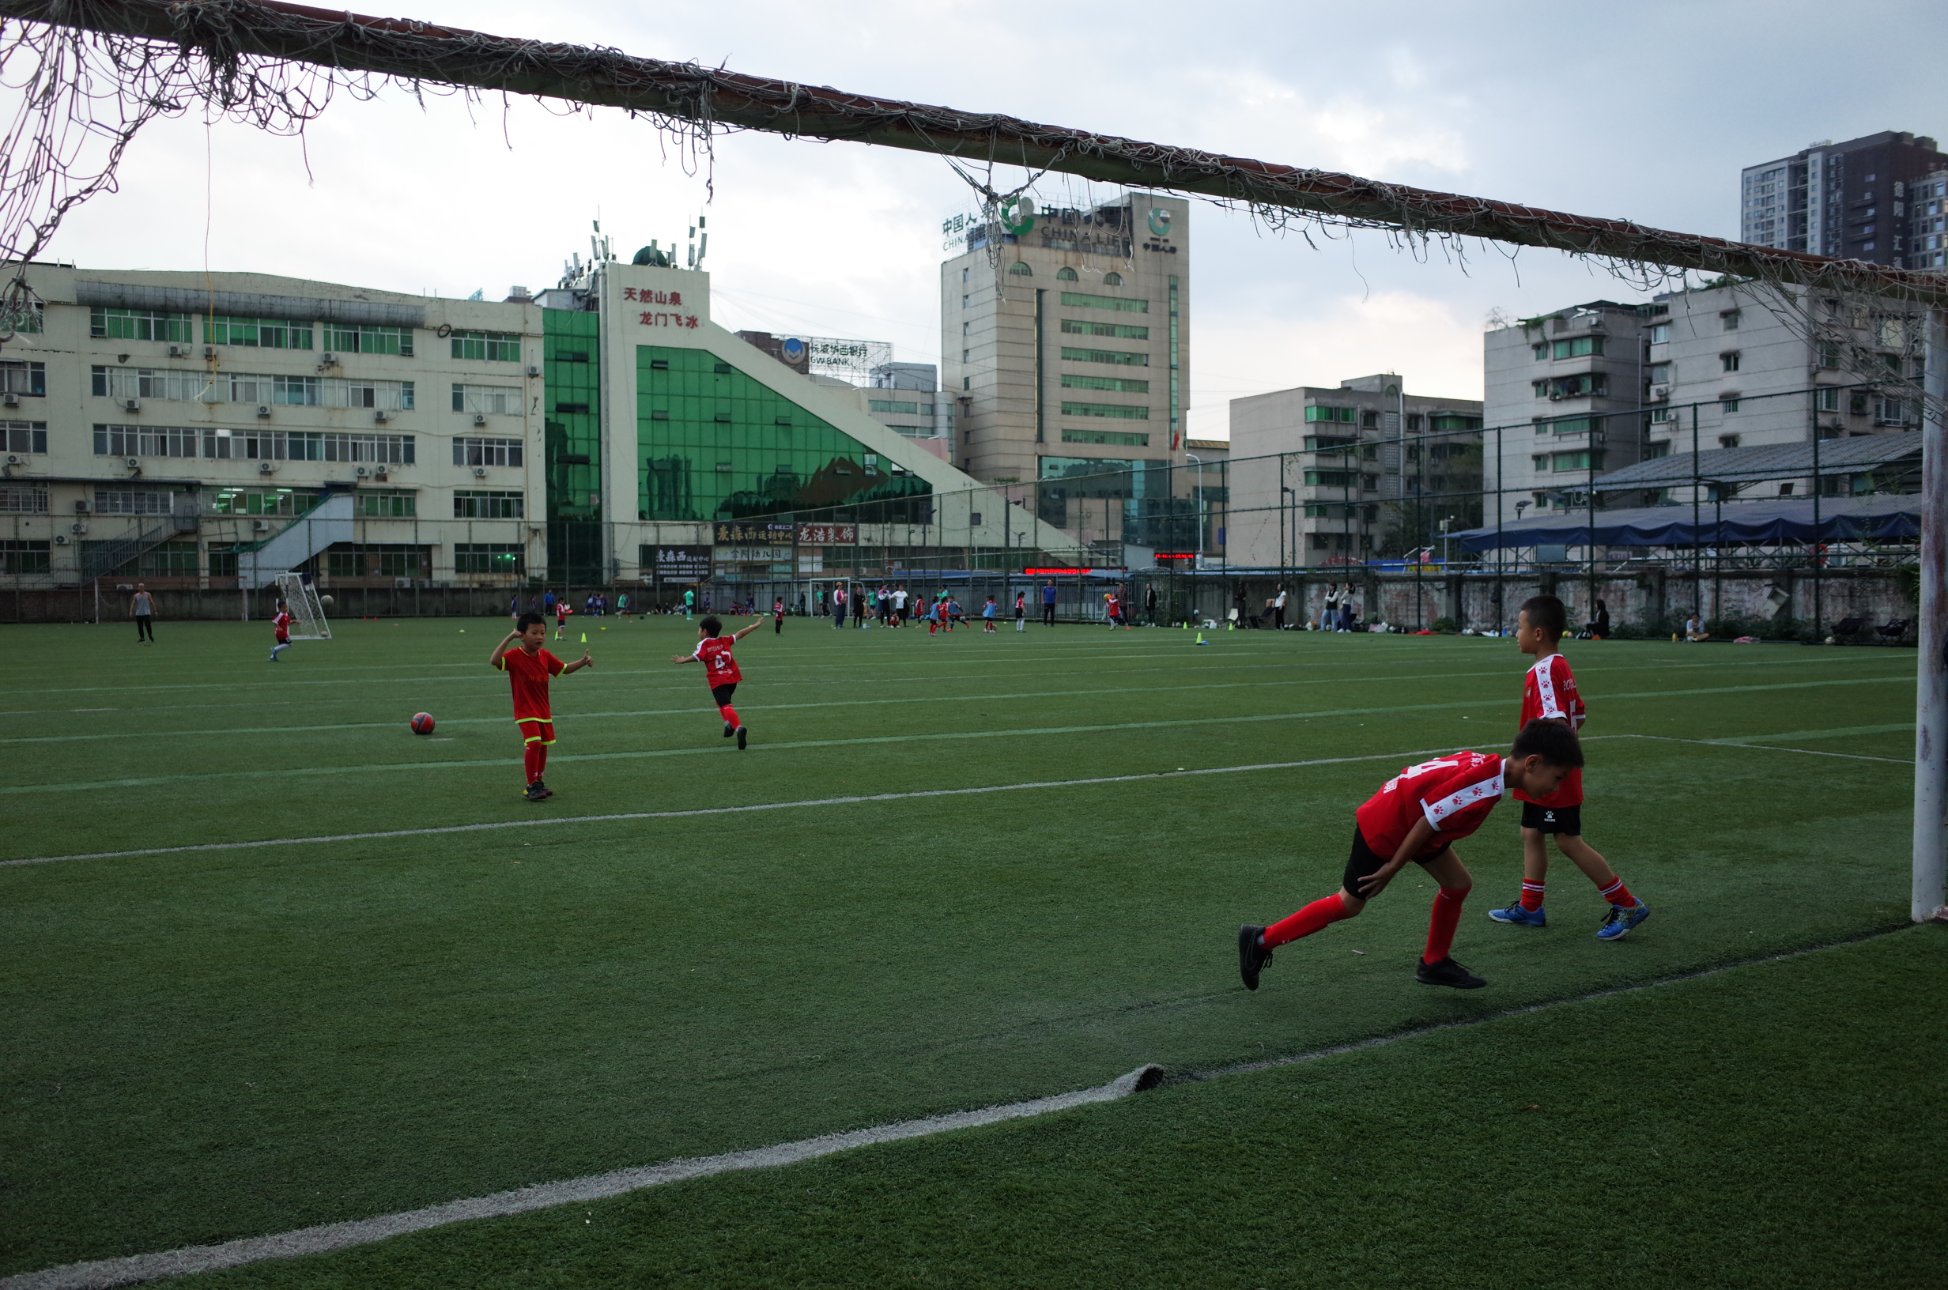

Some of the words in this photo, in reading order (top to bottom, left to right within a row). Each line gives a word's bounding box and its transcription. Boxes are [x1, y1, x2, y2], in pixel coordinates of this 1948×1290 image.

[623, 287, 682, 306] 天然山泉
[640, 310, 699, 329] 龙门飞冰
